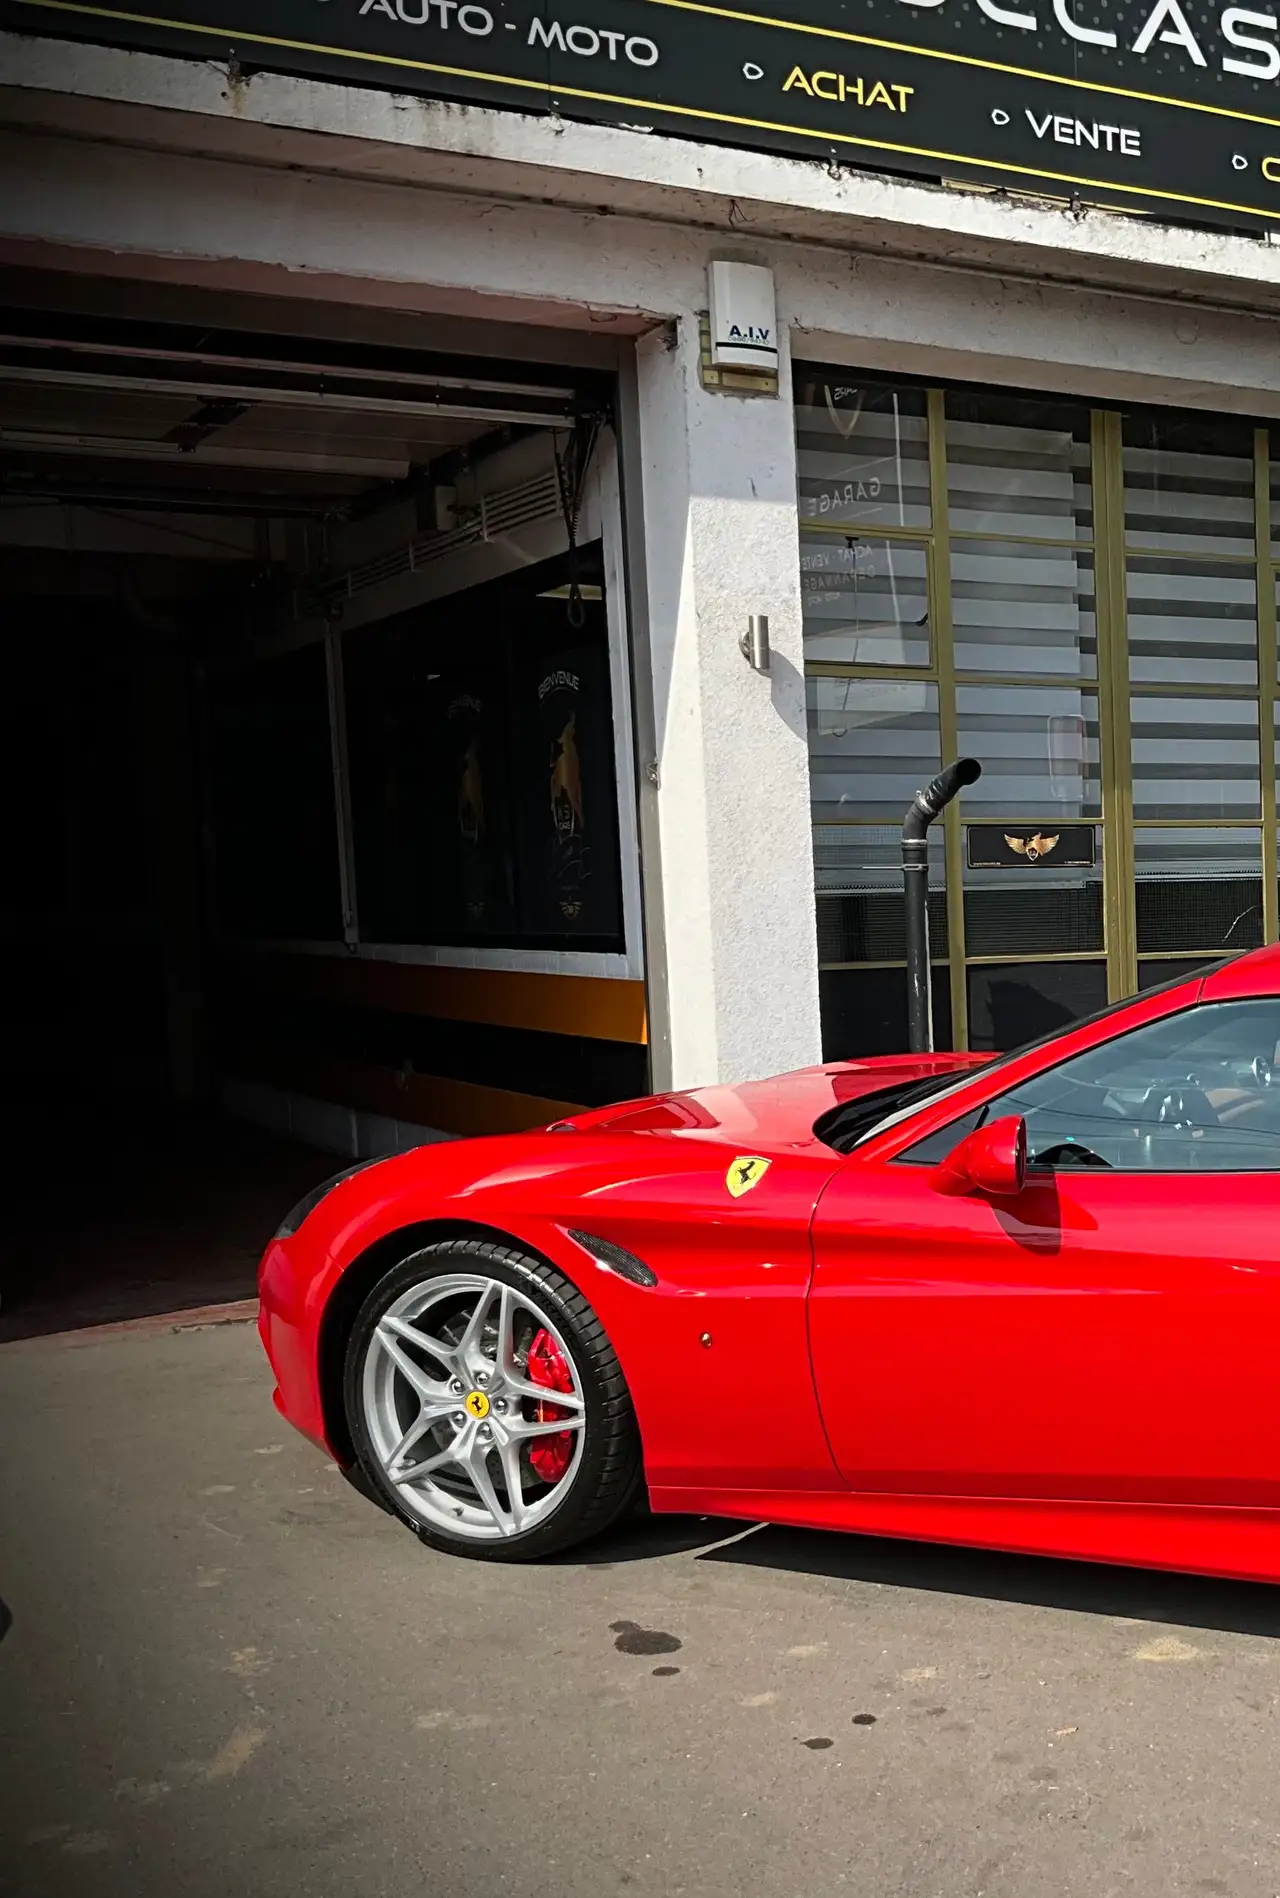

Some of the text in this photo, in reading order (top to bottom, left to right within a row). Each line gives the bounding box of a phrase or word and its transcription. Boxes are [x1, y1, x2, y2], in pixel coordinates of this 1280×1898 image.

[358, 0, 494, 36] AUTO
[527, 16, 660, 67] MOTO
[781, 66, 915, 114] ACHAT
[1024, 108, 1142, 157] VENTE
[729, 324, 770, 341] A.I.V
